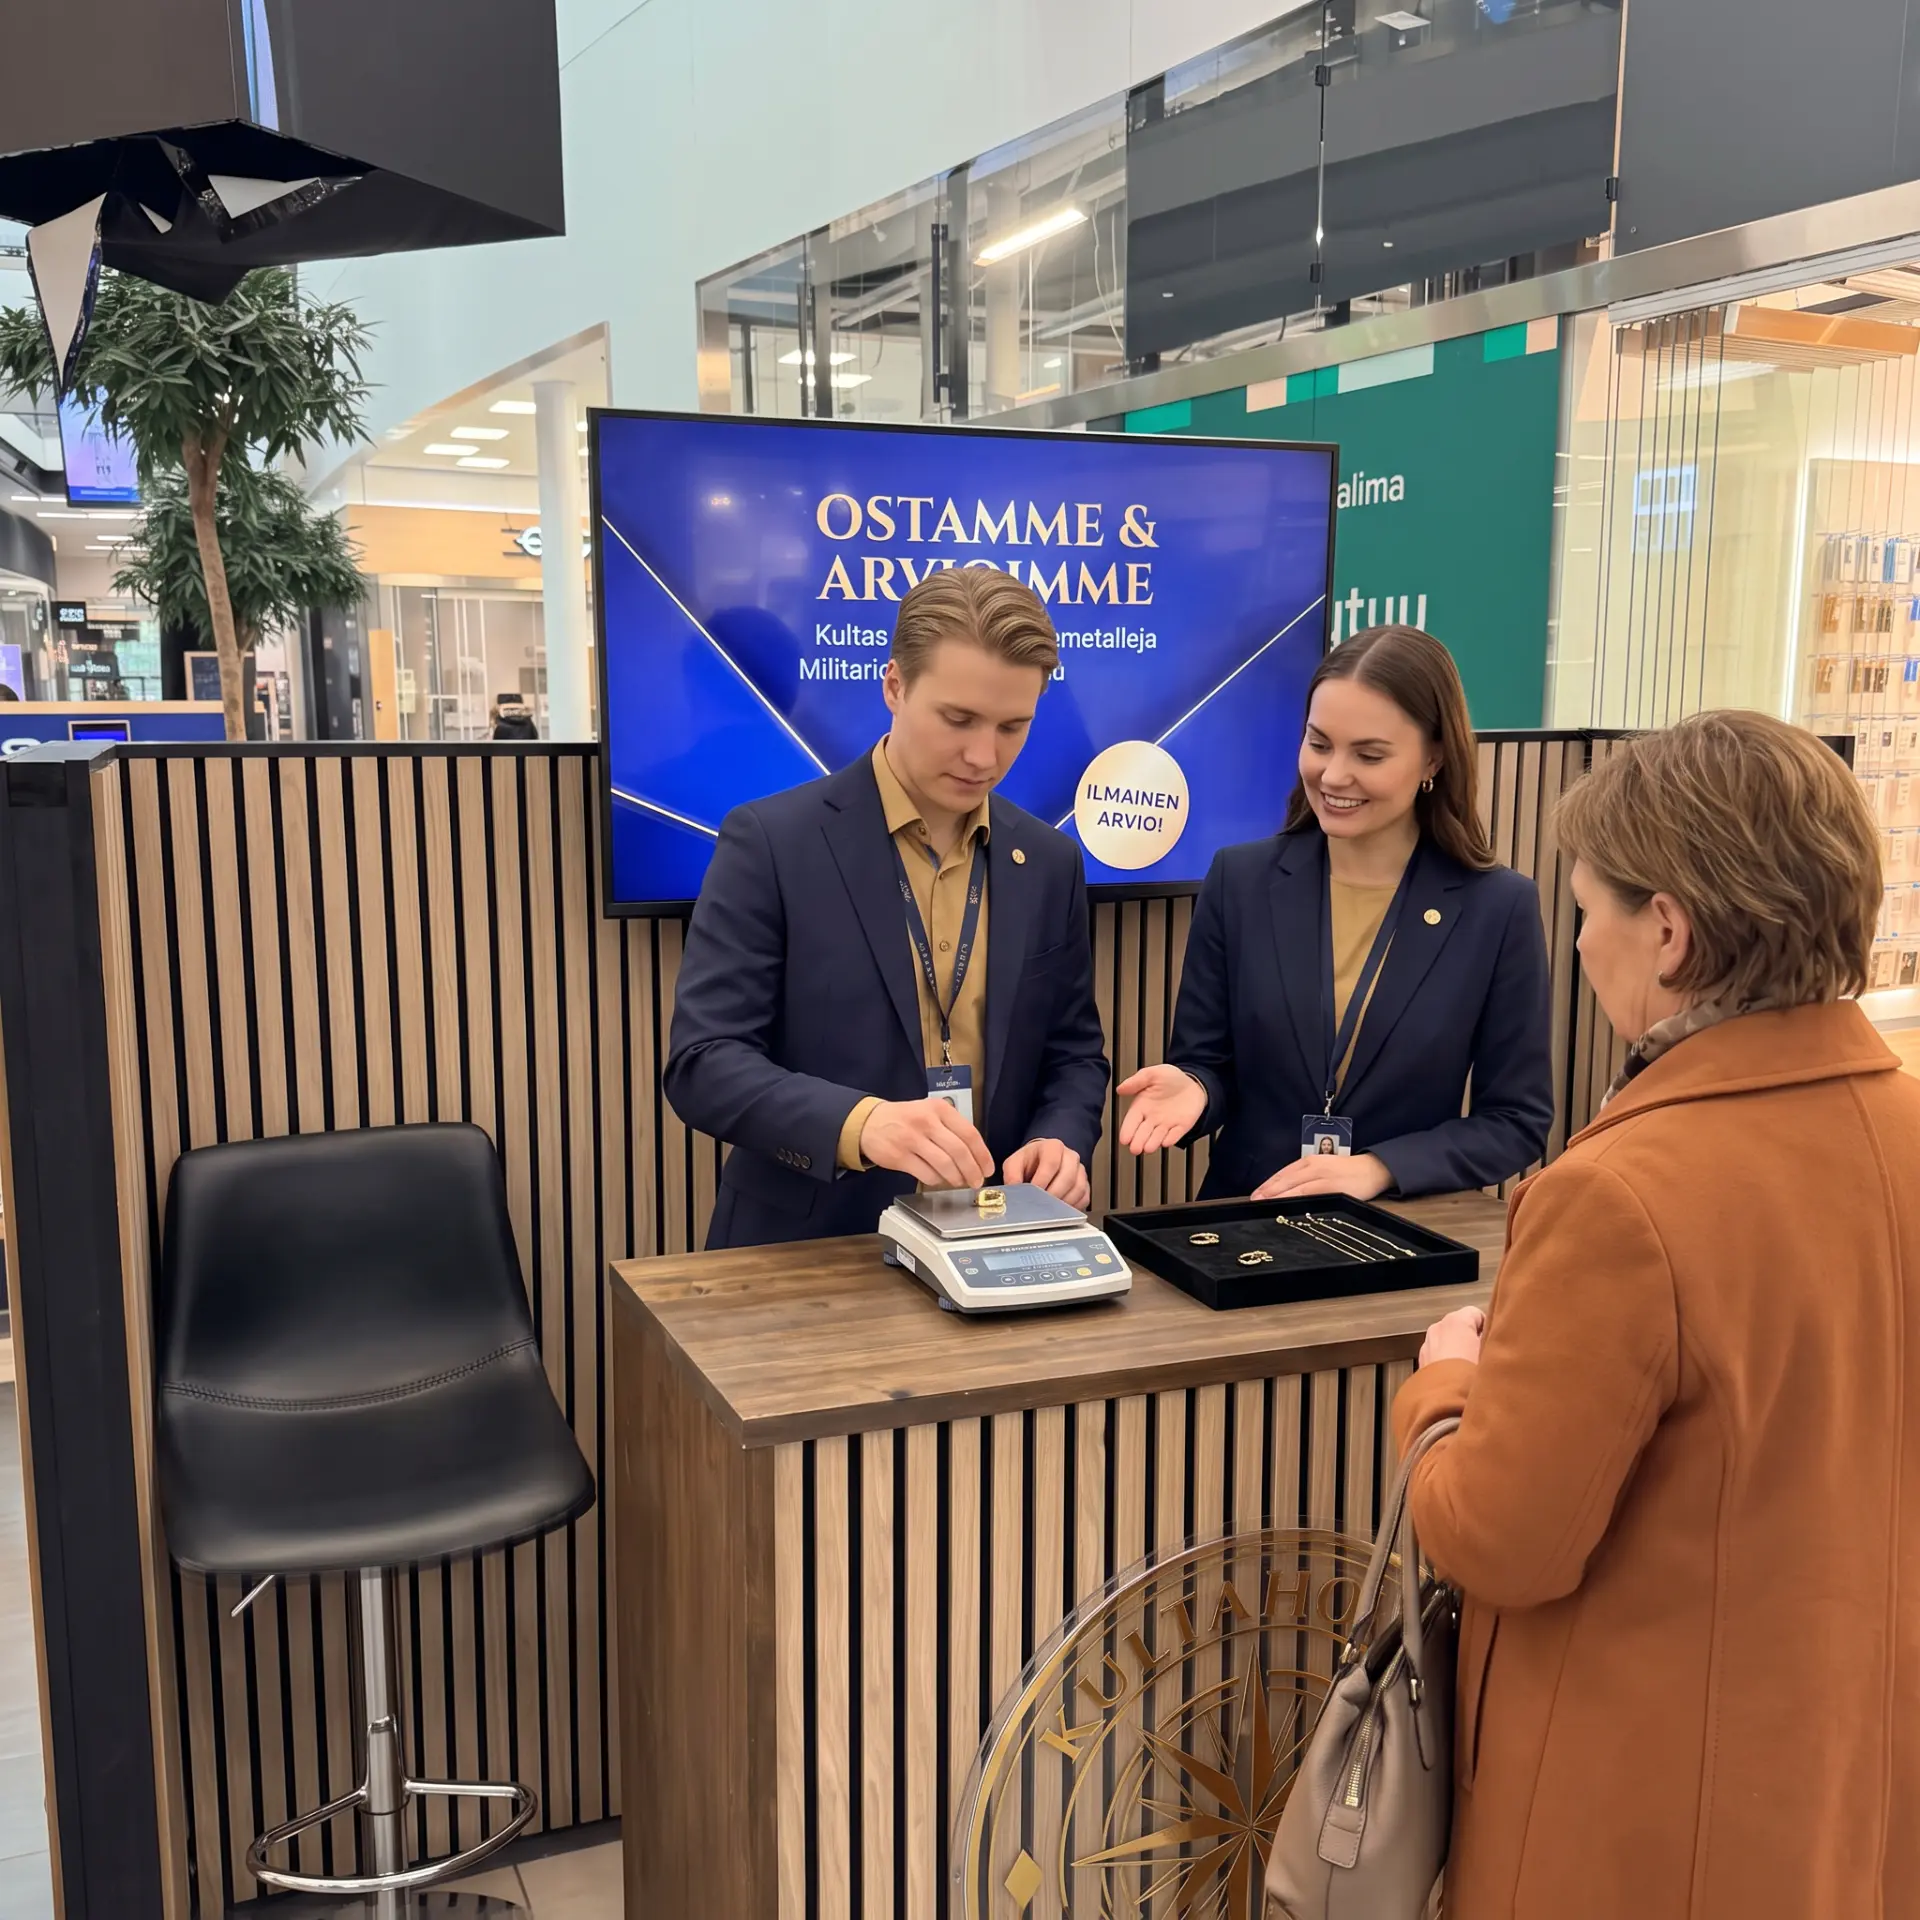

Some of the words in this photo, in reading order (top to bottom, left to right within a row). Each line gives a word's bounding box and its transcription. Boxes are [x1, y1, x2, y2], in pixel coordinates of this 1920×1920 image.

[816, 493, 1104, 547] OSTAMME
[1119, 504, 1159, 548] &
[815, 554, 1154, 605] ARVMME
[815, 623, 888, 646] Kultas
[1087, 784, 1179, 810] ILMAINEN
[1097, 811, 1163, 833] ARVIO!
